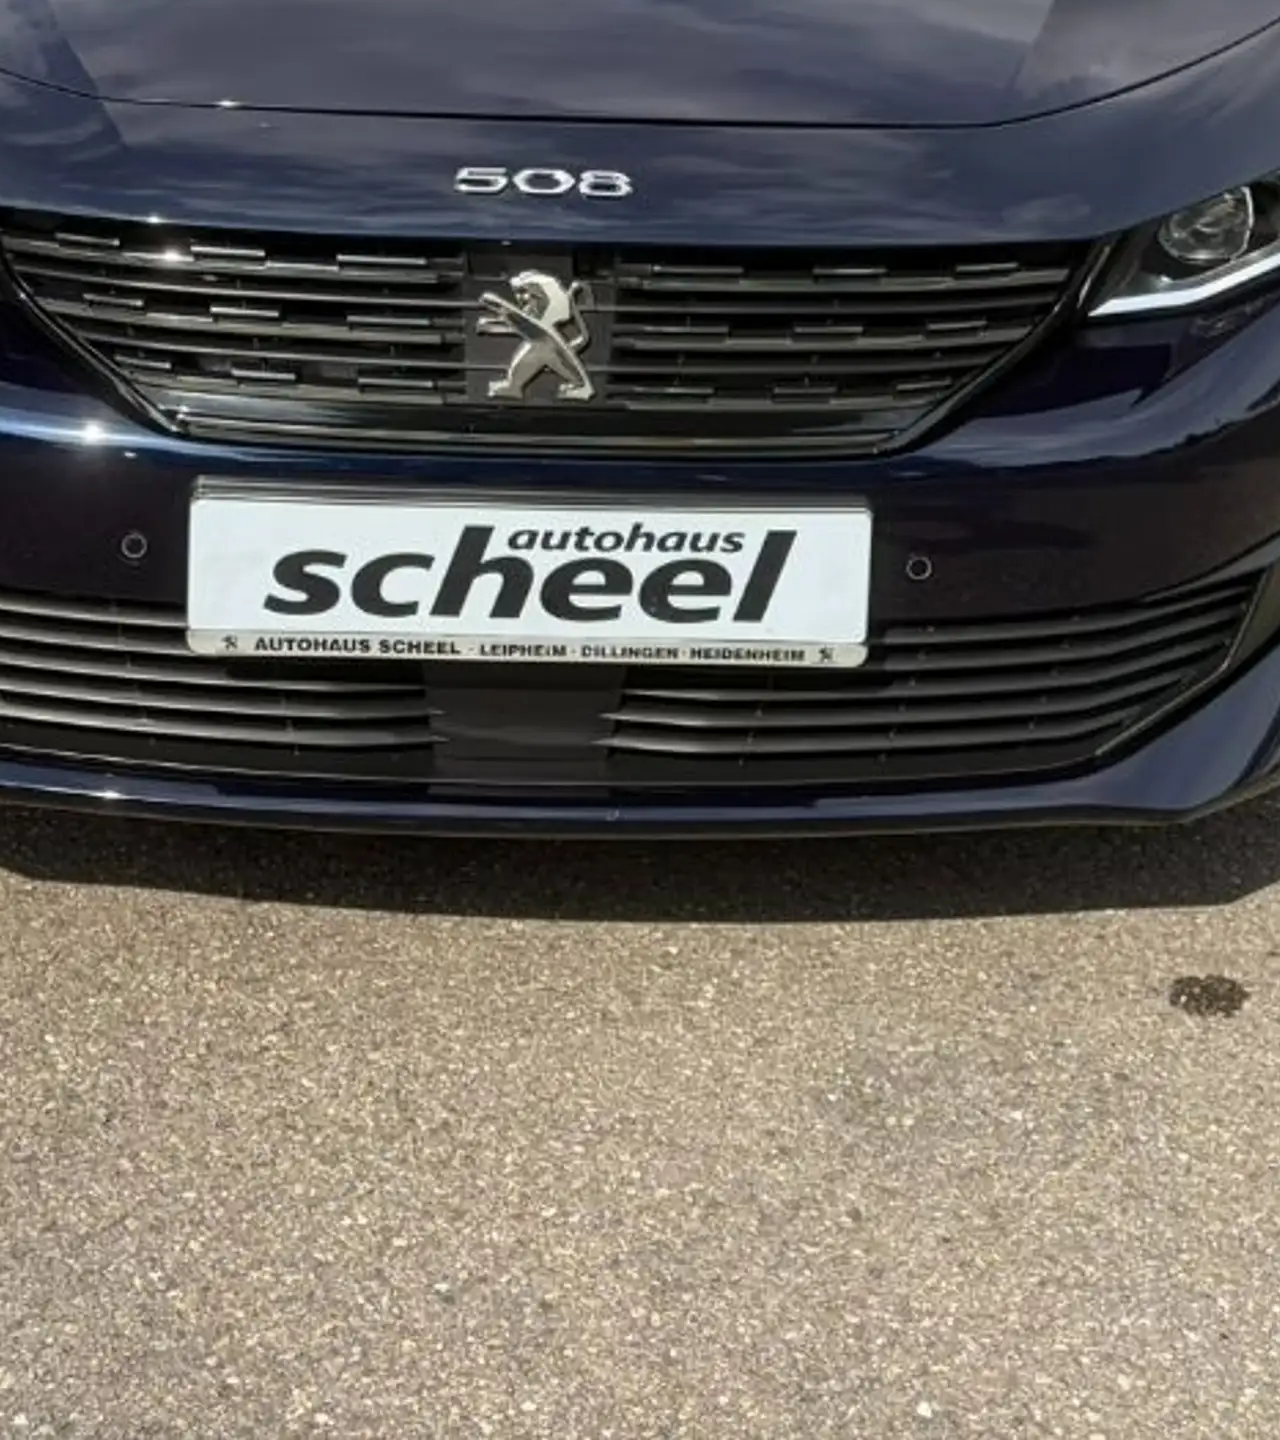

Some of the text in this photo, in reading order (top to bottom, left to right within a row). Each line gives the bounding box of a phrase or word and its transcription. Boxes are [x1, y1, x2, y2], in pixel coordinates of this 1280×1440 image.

[454, 167, 635, 197] 508
[507, 522, 745, 554] autohaus
[263, 525, 797, 623] scheel
[254, 637, 806, 662] AUTOHAUS SCHEEL LEIPHEIM DILLINGEN HEIDENHEIM
